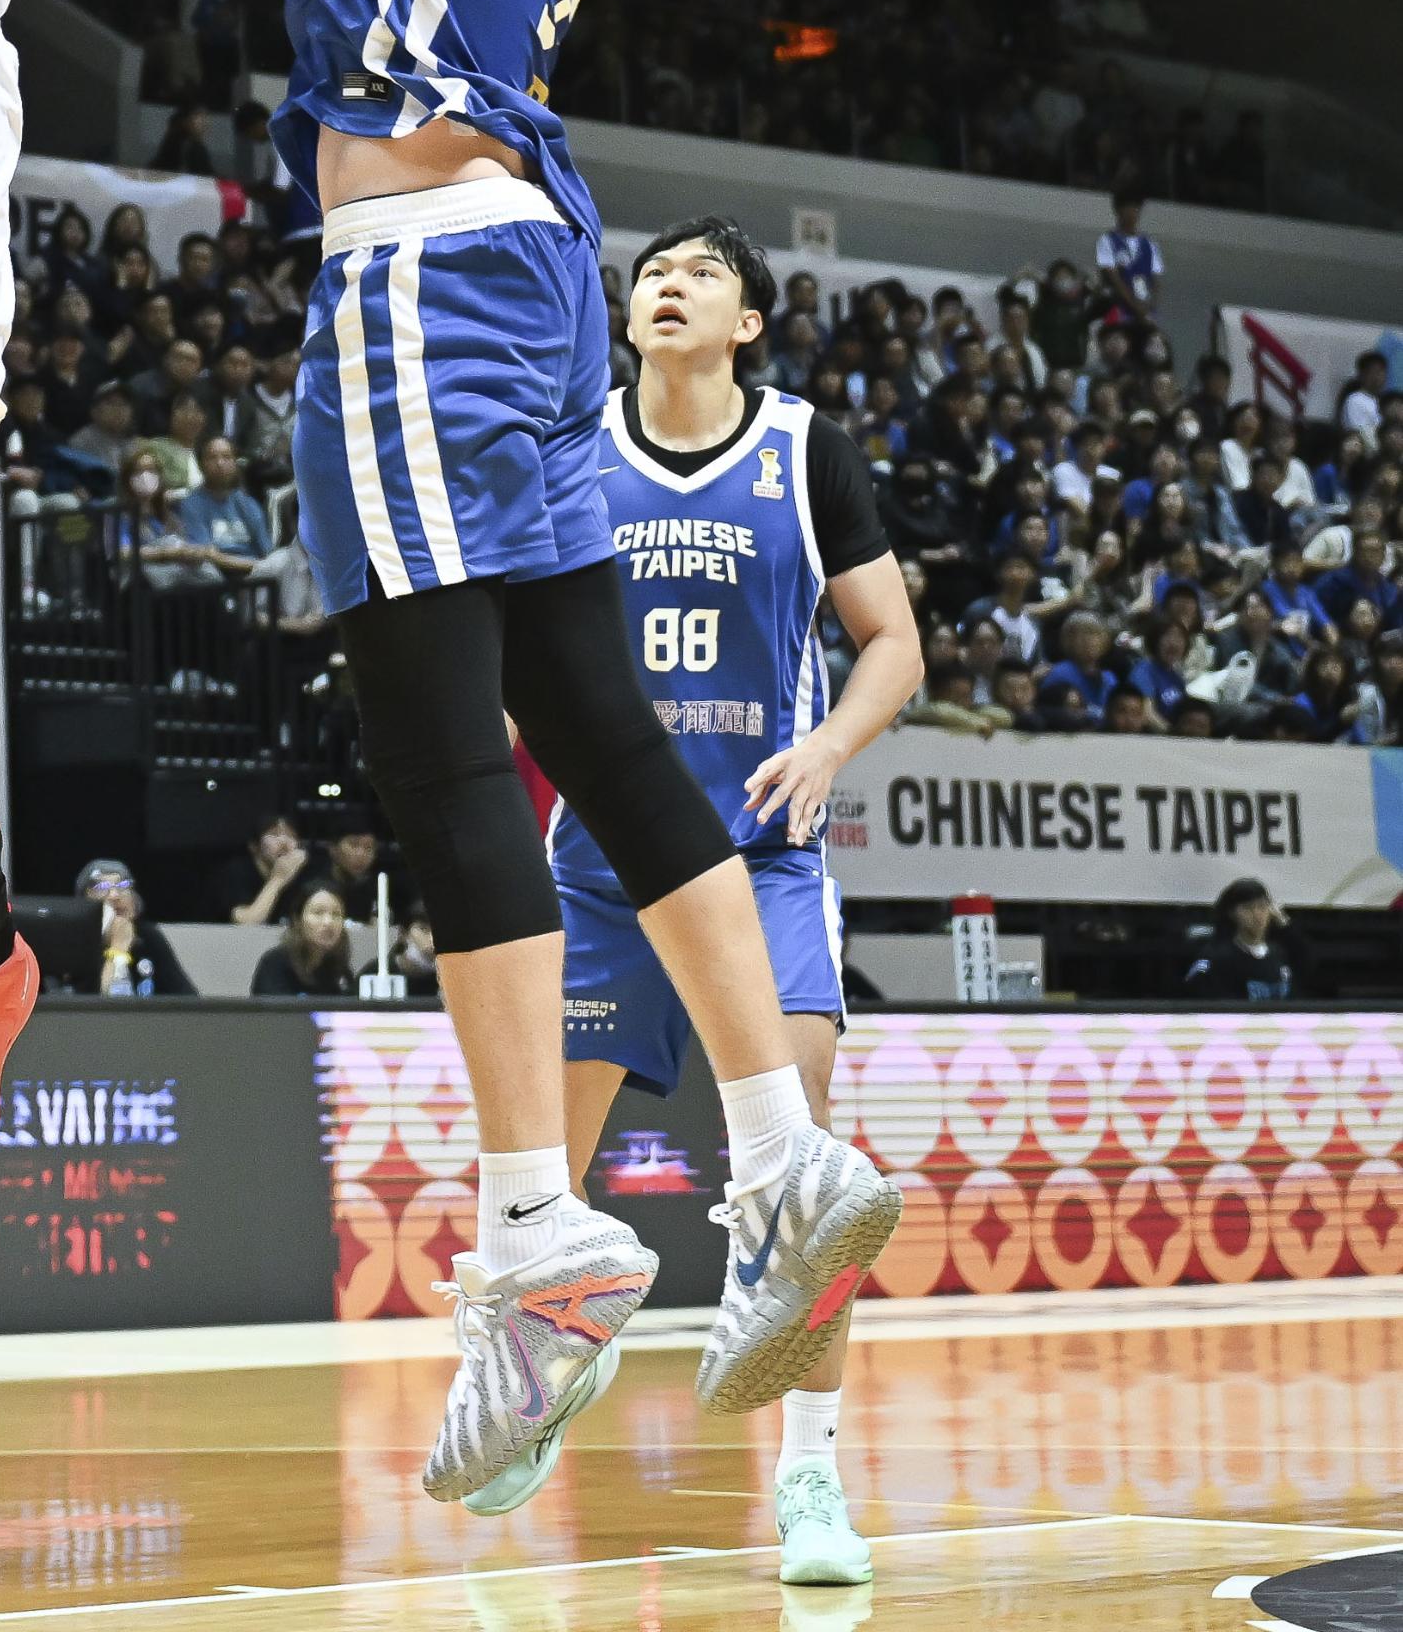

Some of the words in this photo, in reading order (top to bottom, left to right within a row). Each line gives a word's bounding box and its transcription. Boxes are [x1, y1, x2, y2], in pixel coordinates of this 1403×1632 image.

[612, 519, 757, 559] CHINESE
[629, 549, 738, 585] TAIPEI
[643, 607, 721, 672] 88
[887, 775, 1125, 852] CHINESE
[1136, 784, 1303, 857] TAIPEI
[563, 999, 617, 1011] EAMERS
[563, 1008, 608, 1018] ADEMY
